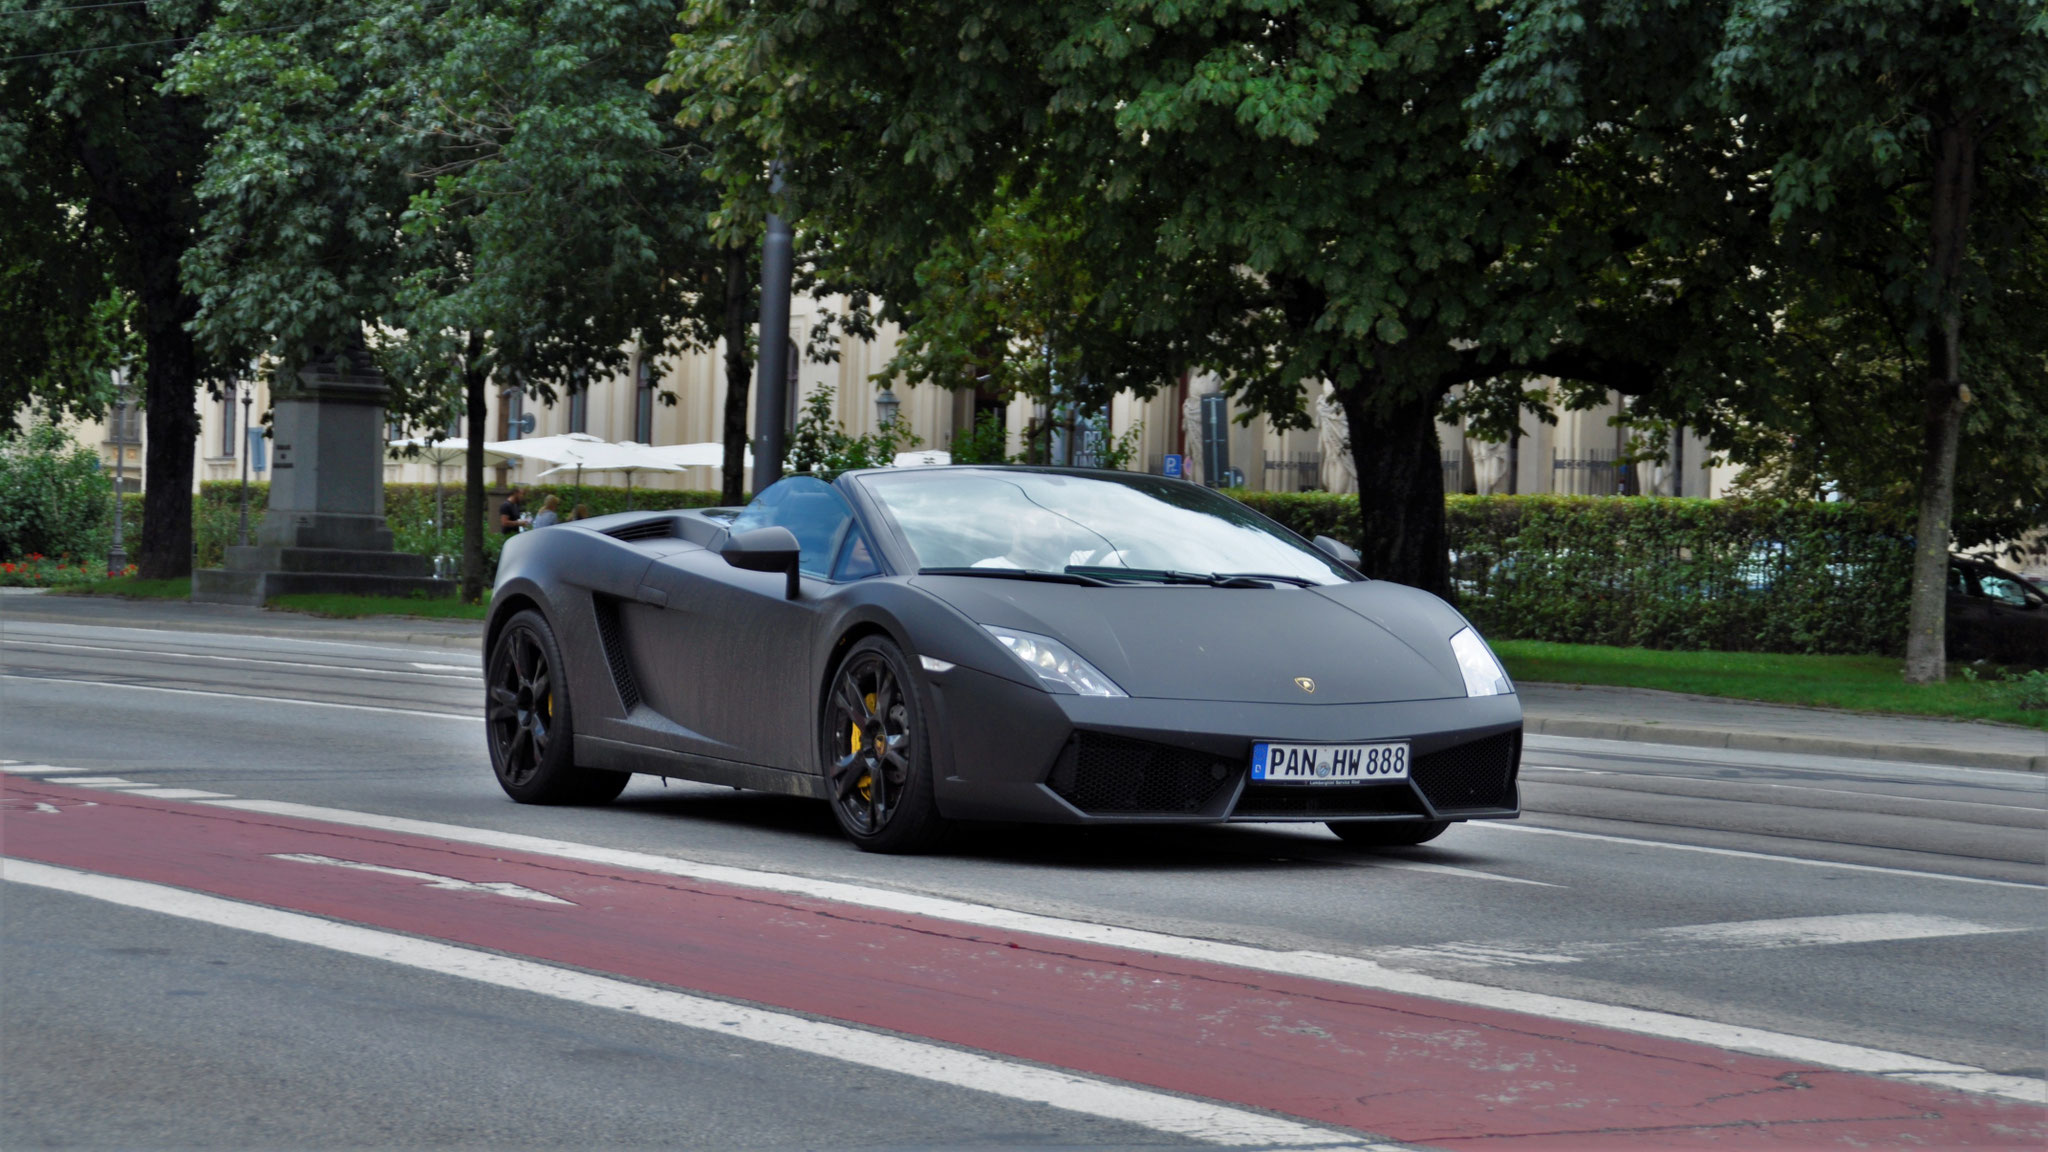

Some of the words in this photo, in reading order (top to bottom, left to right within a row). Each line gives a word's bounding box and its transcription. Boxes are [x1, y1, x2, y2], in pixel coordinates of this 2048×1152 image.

[1166, 457, 1177, 473] P
[1269, 748, 1317, 776] PAN
[1331, 748, 1362, 776] HW
[1366, 746, 1405, 775] 888
